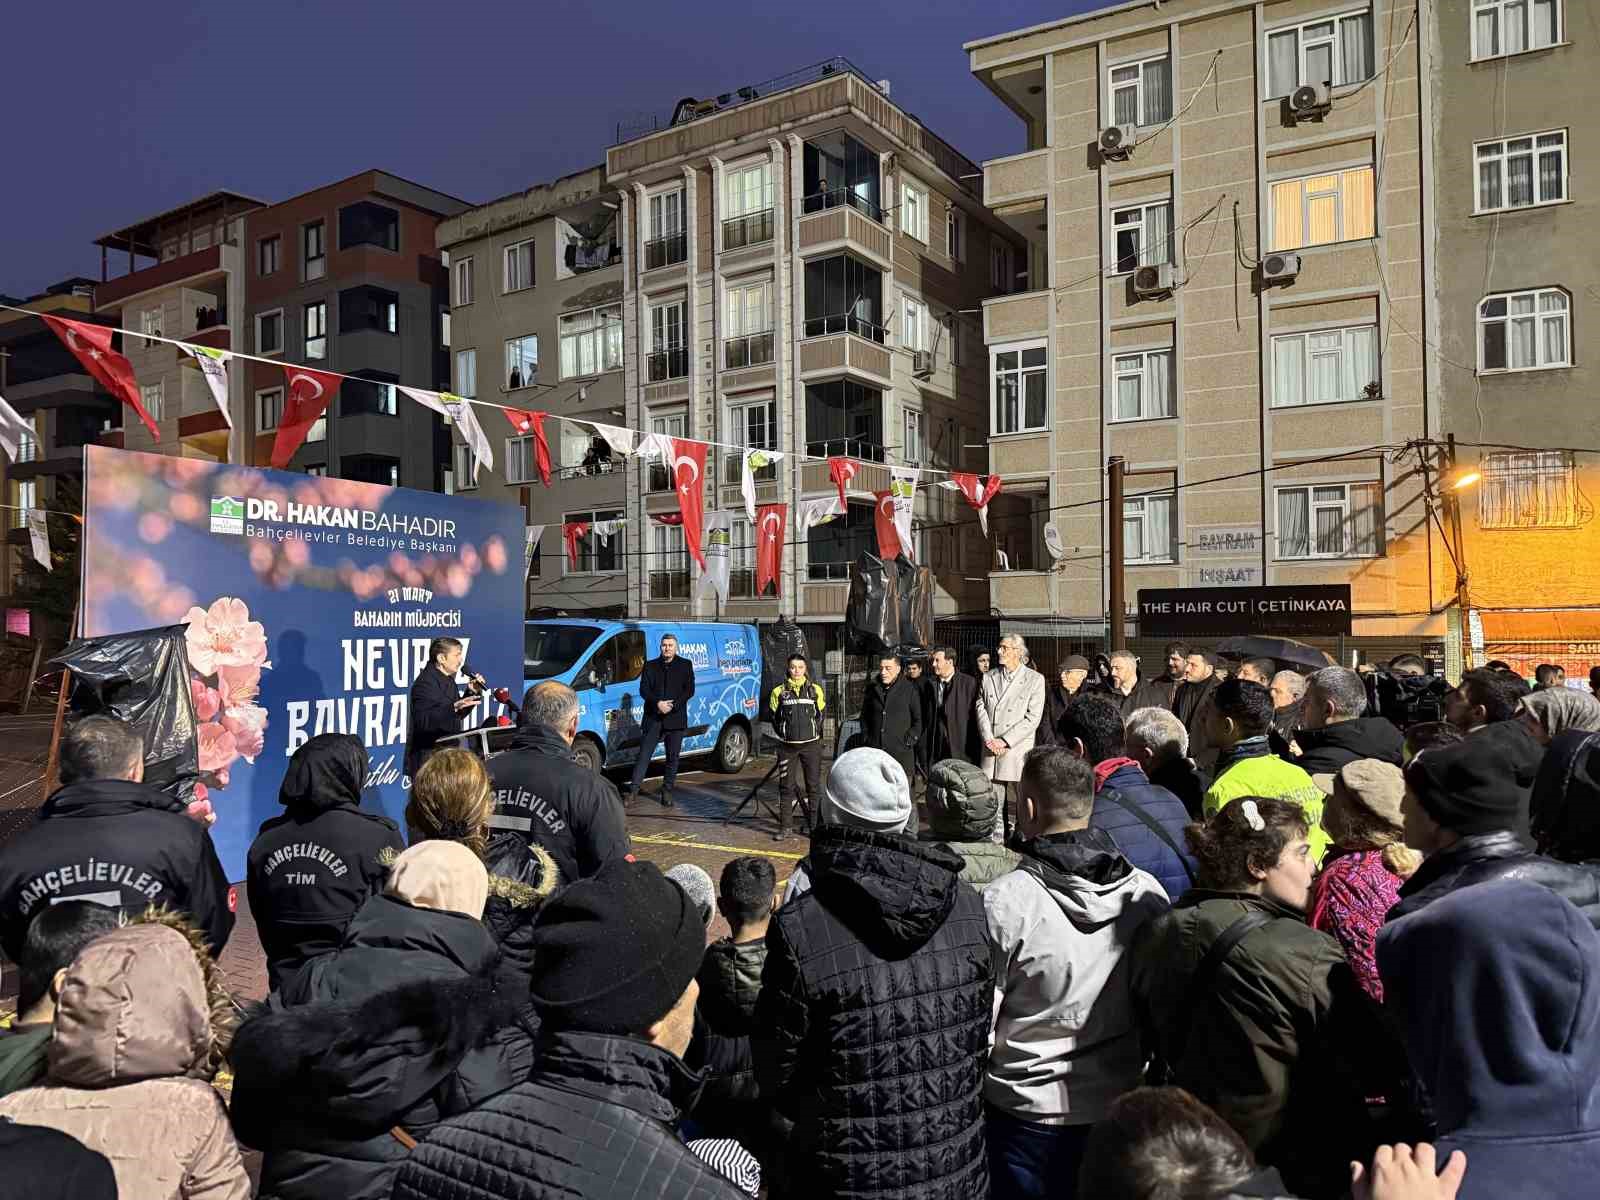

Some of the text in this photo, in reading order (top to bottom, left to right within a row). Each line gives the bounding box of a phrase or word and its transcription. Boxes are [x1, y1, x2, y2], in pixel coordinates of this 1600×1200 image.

[247, 497, 456, 539] DR. HAKAN BAHADIR
[246, 524, 341, 544] Bahçelievler
[347, 532, 405, 551] Belediye
[410, 538, 456, 553] Başkanı
[388, 586, 433, 604] 21 MART
[1142, 596, 1346, 615] THE HAIR CUT ÇETİNKAYA
[354, 609, 461, 627] BAHARIN MÜJDECİSİ
[1567, 643, 1600, 654] SAH
[342, 637, 471, 691] NEVRZ
[489, 786, 566, 834] ELİEVLER
[285, 871, 316, 885] TİM
